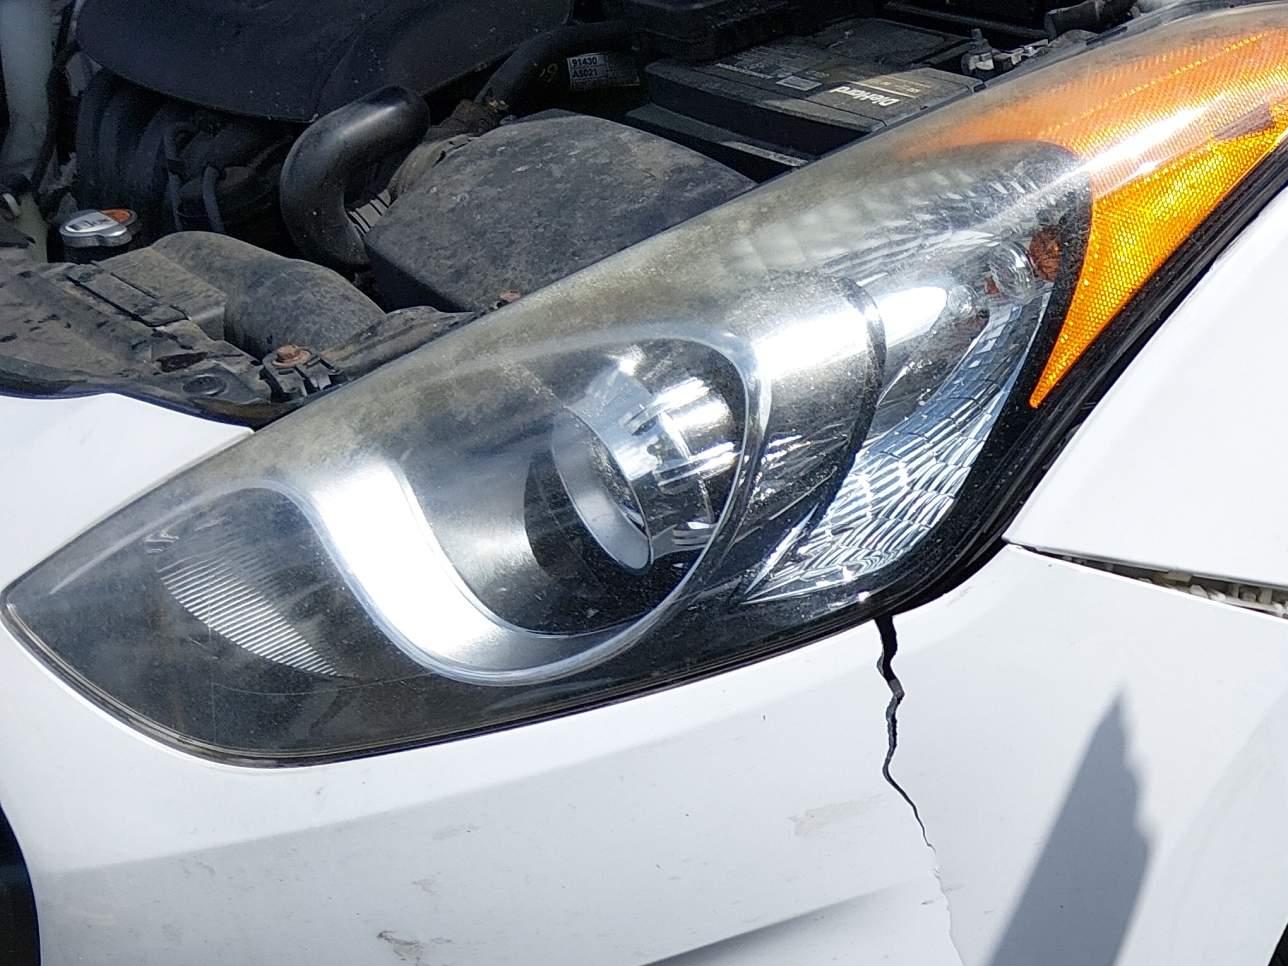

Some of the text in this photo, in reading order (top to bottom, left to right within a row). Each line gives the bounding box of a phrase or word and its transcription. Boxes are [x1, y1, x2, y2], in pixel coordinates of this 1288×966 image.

[571, 55, 598, 67] 91430
[572, 67, 598, 78] A5021
[828, 86, 901, 107] DieHard
